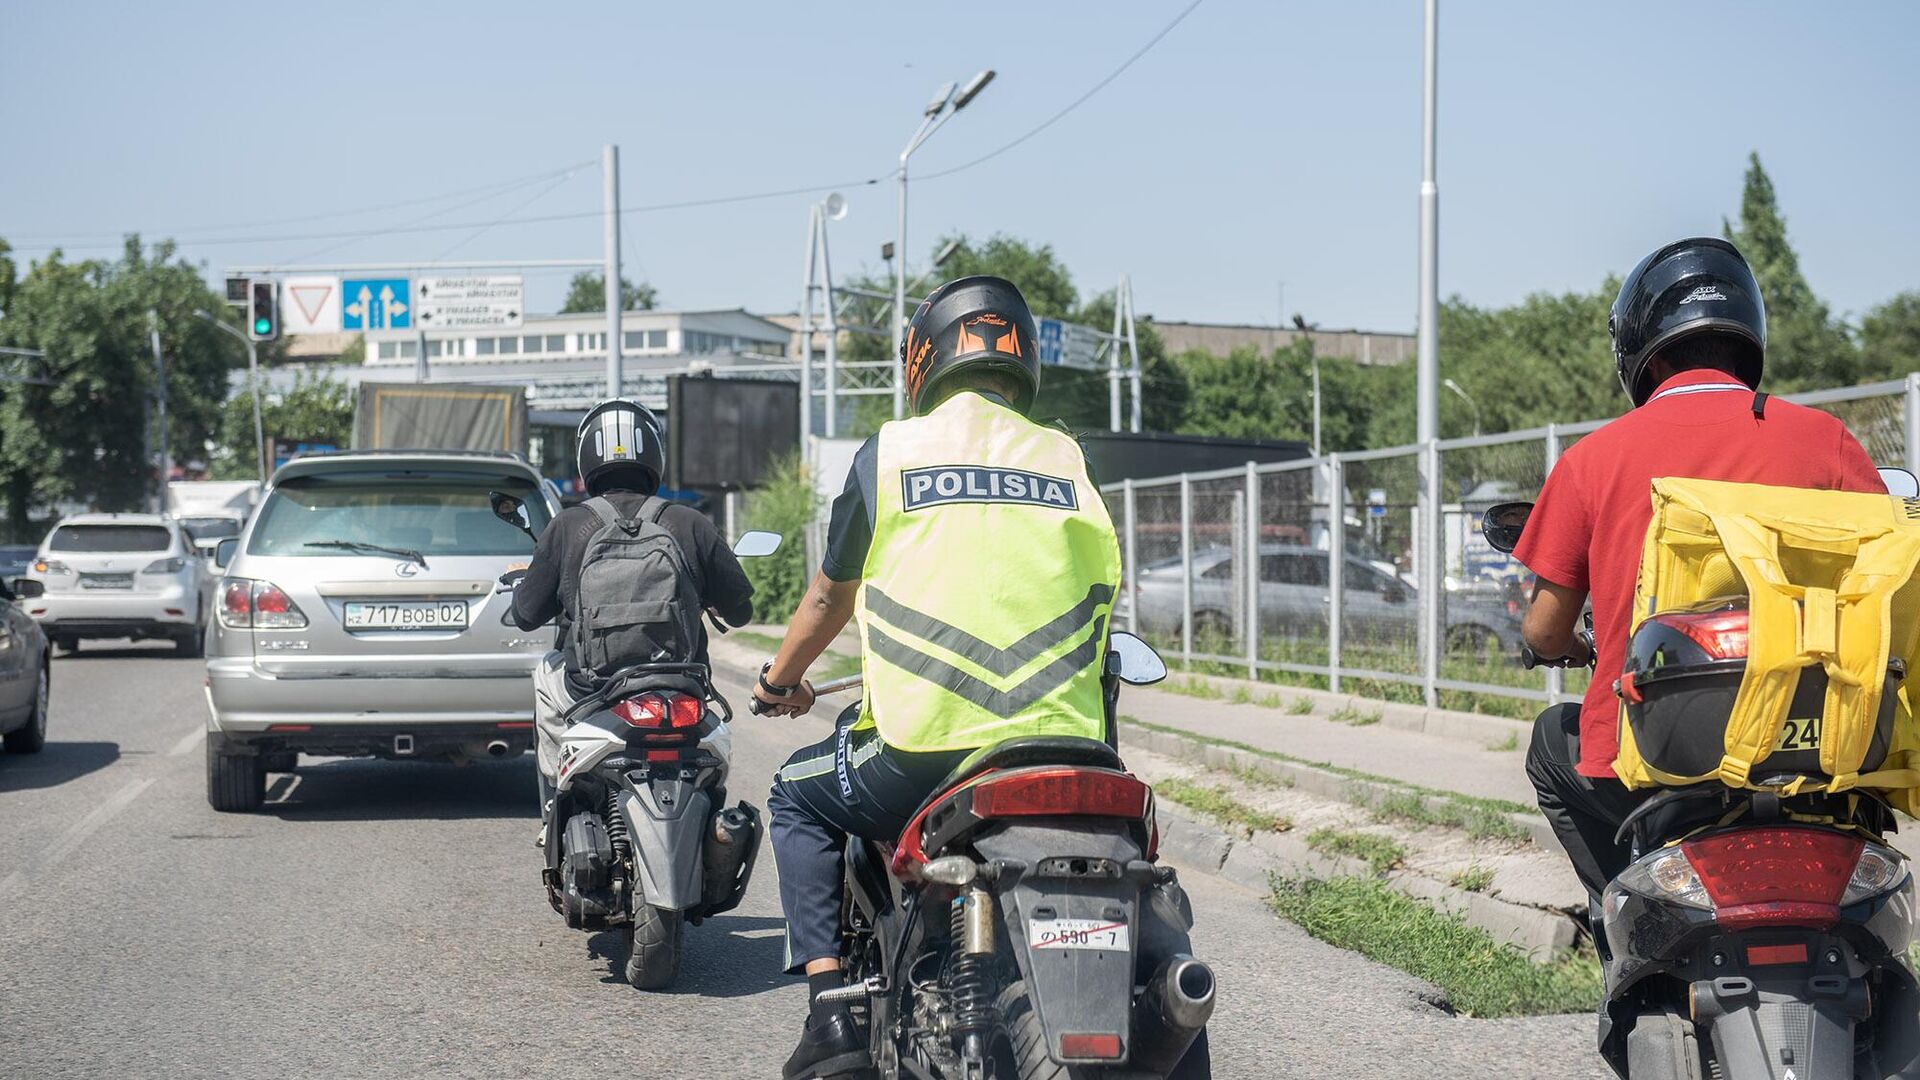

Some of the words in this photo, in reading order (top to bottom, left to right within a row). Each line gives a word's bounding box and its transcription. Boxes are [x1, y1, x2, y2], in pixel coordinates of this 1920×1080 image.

[910, 471, 1069, 505] POLISIA
[348, 616, 361, 624] KZ
[441, 605, 464, 622] 02
[1777, 719, 1818, 749] 24
[838, 727, 851, 792] POLISIA
